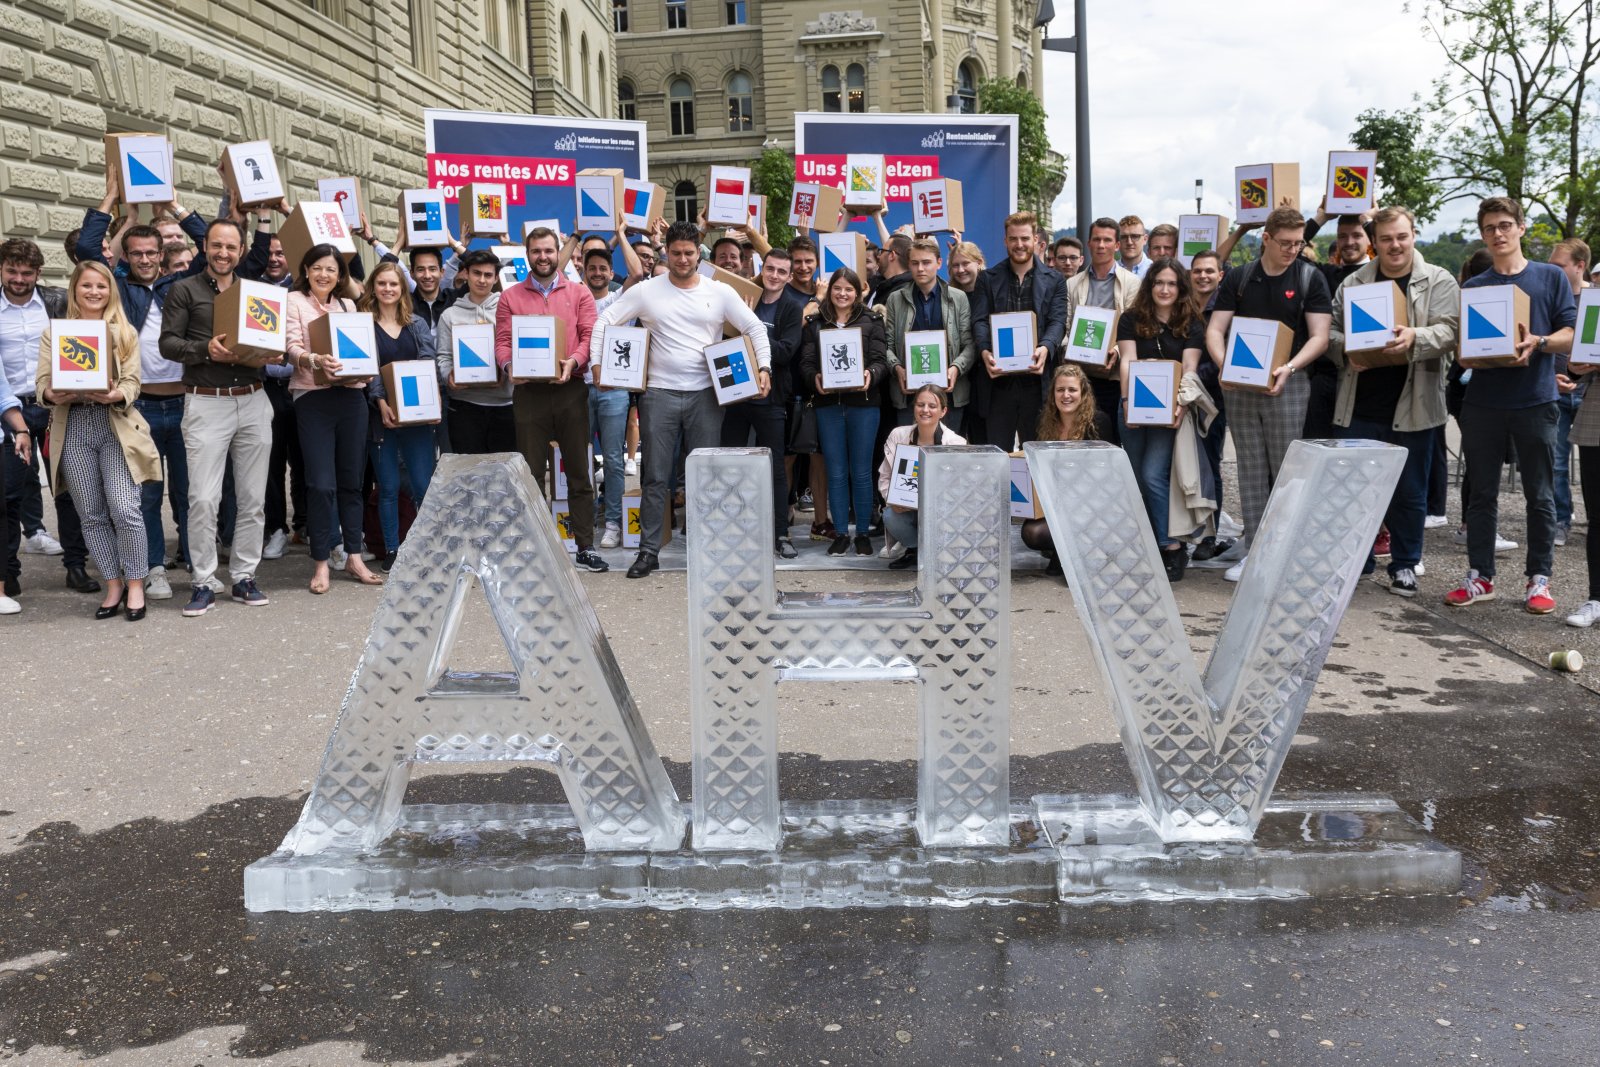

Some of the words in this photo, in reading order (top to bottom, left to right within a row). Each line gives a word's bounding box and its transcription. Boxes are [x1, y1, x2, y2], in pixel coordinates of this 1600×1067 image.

[946, 132, 997, 140] Renteninitiative
[434, 160, 470, 177] Nos
[474, 163, 531, 179] rentes
[535, 164, 569, 181] AVS
[803, 161, 837, 176] Uns
[829, 358, 837, 367] V
[849, 358, 857, 366] R
[277, 439, 1408, 853] AHV
